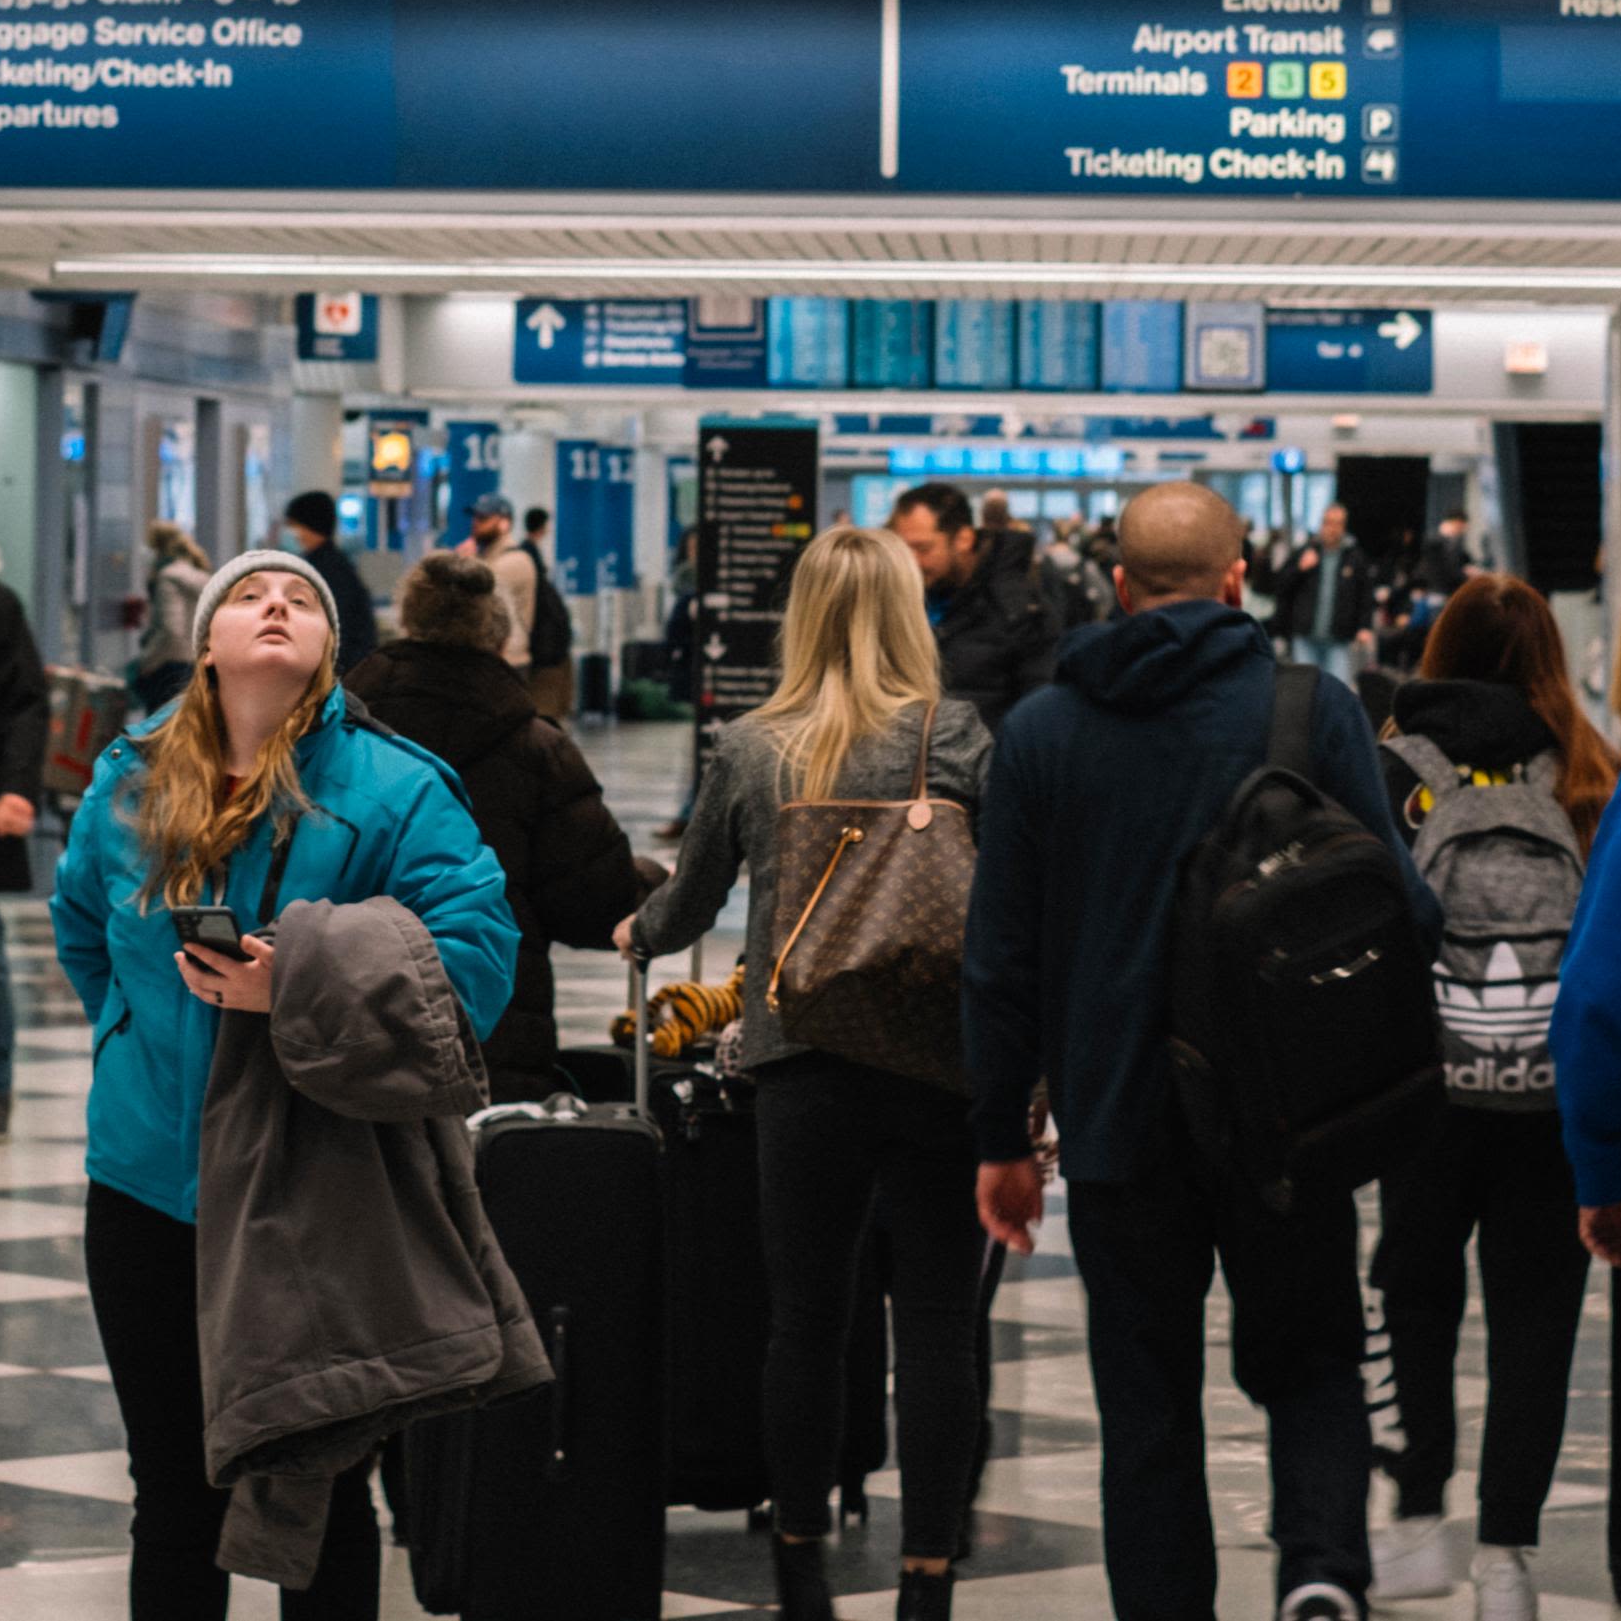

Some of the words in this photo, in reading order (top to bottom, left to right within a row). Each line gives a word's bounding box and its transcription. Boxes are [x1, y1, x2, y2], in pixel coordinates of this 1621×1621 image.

[94, 17, 206, 46] Service
[212, 18, 302, 46] Office
[1132, 25, 1238, 58] Airport
[1243, 25, 1344, 54] Transit
[1060, 65, 1208, 95] Terminals
[1230, 107, 1345, 143] Parking
[1065, 148, 1203, 183] Ticketing
[1209, 148, 1345, 179] Check-In
